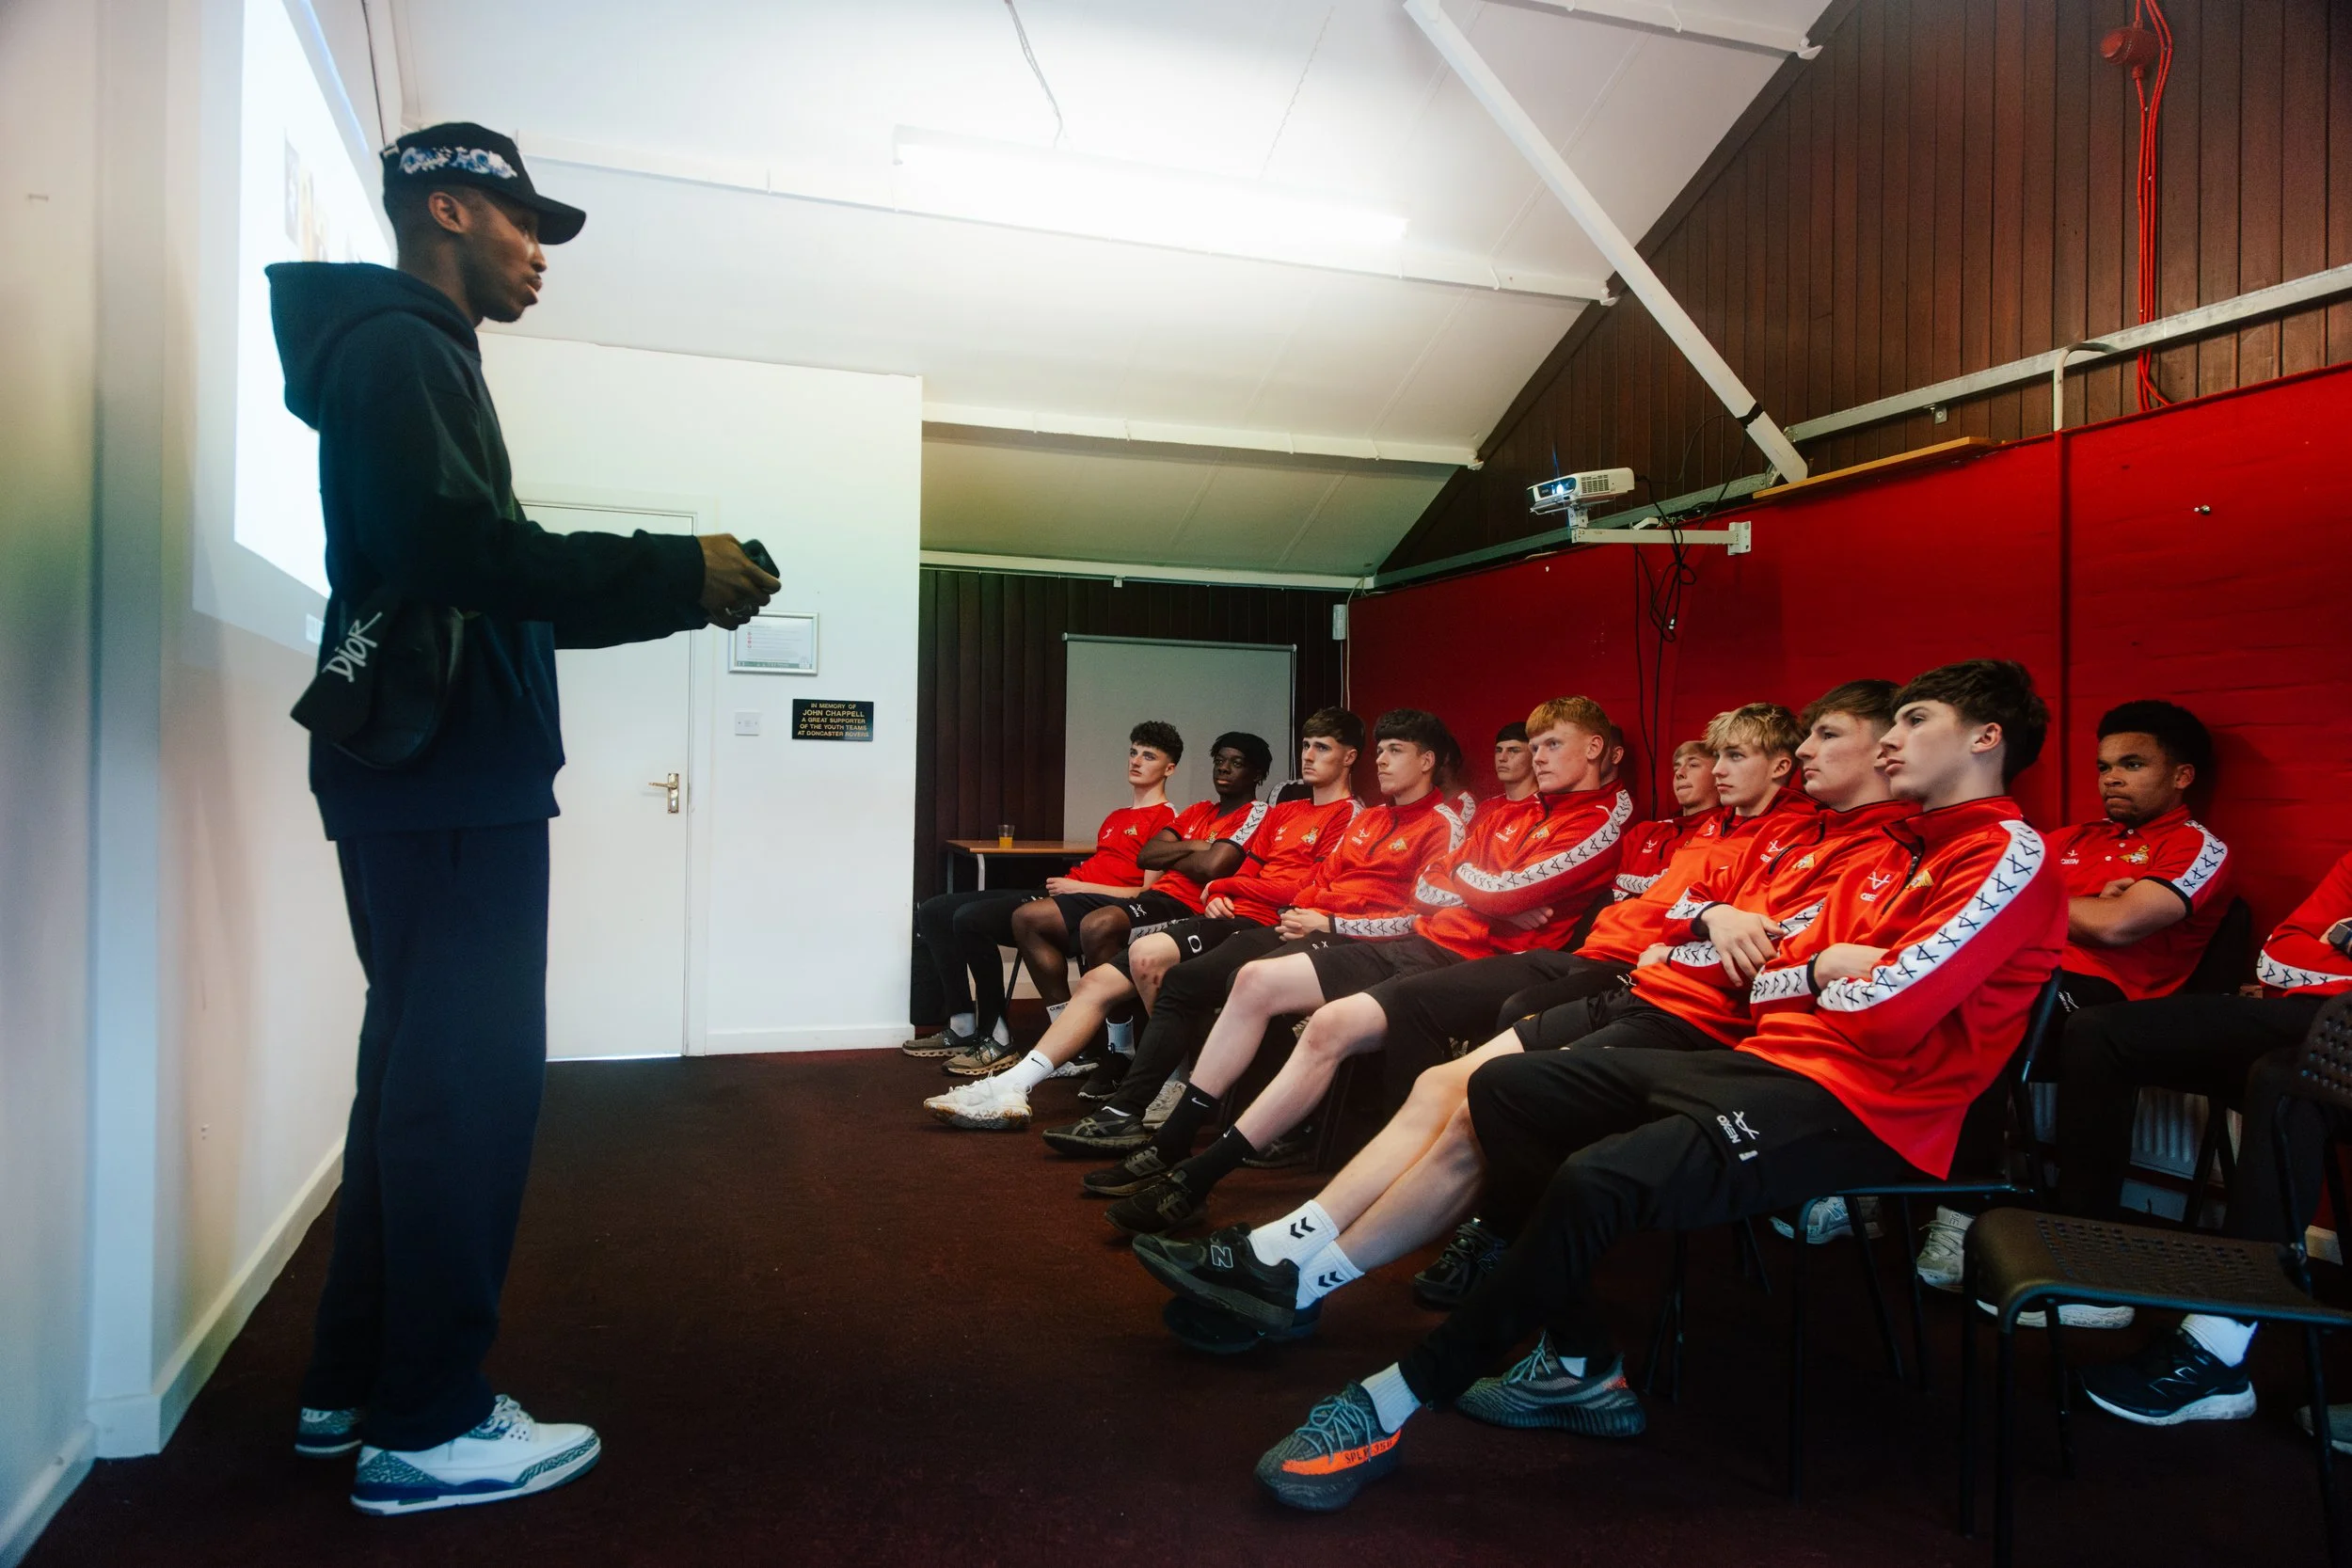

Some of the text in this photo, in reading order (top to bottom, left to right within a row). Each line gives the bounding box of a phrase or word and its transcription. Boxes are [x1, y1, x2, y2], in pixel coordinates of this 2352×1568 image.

[825, 709, 865, 718] CHAPPELL
[1716, 1115, 1741, 1143] OXEN
[1210, 1244, 1234, 1269] N
